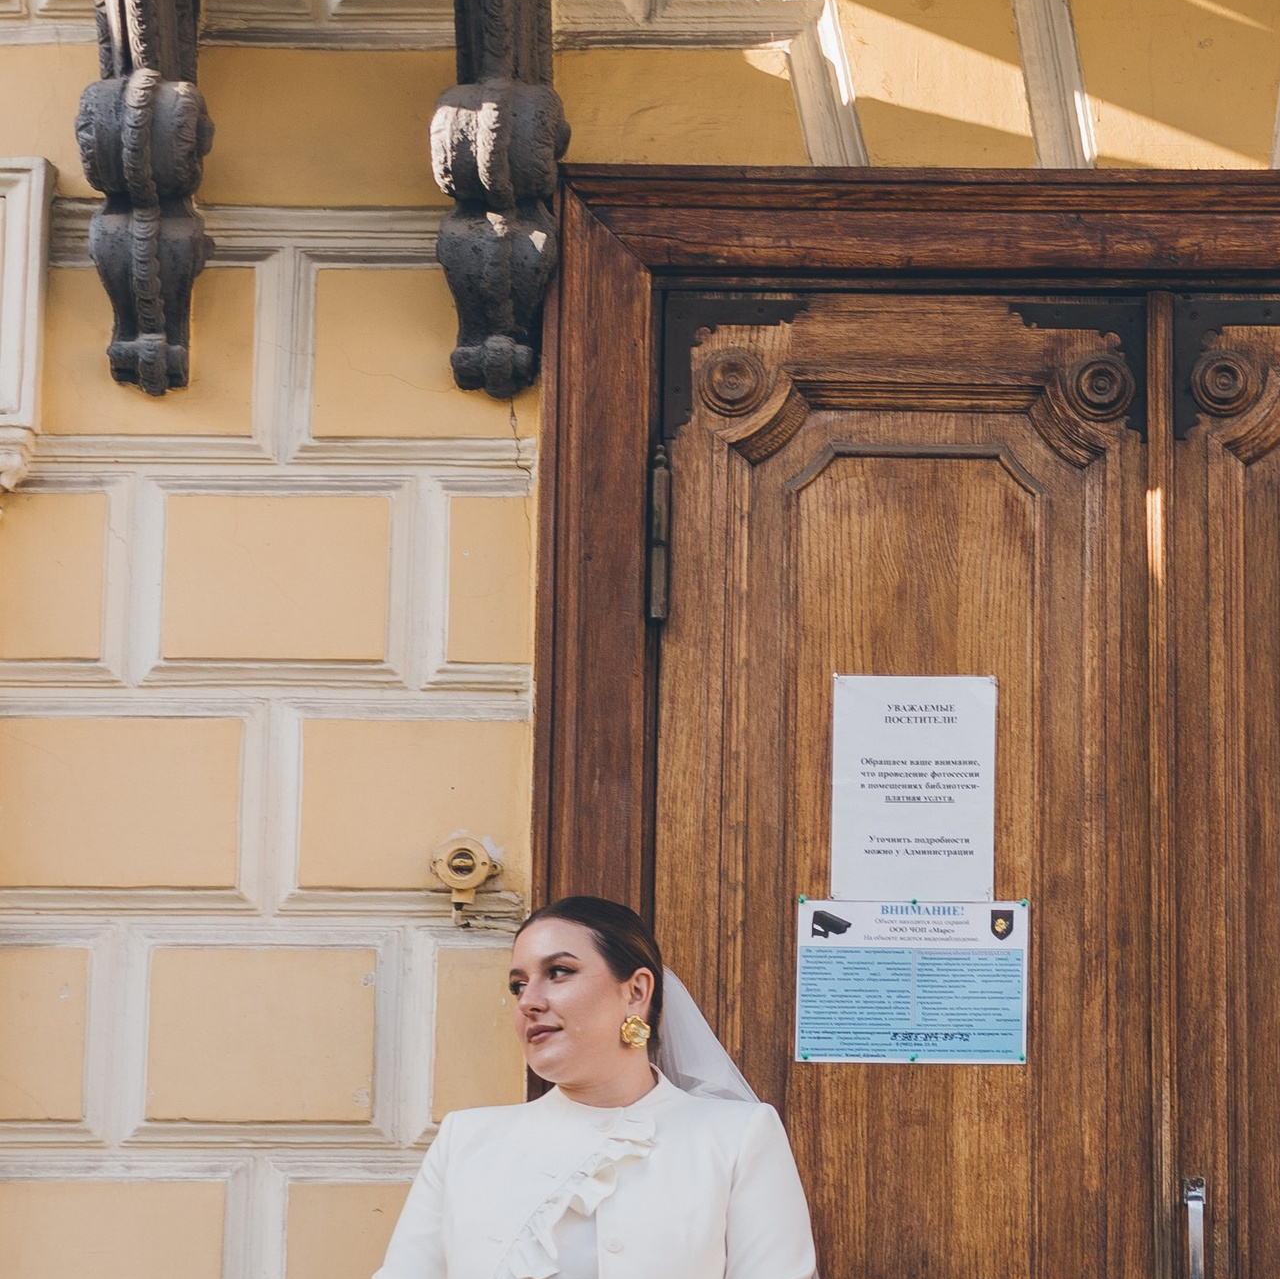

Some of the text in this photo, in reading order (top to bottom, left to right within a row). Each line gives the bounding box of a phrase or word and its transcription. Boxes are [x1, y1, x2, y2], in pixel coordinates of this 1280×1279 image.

[887, 704, 956, 712] УВАЖАЕМЫЕ
[884, 716, 958, 724] ПОСЕТИТЕЛИ!
[861, 758, 907, 767] Обращаем
[878, 771, 928, 780] проведение
[930, 770, 980, 780] фотосессии
[869, 835, 970, 846] Уточнить подробности
[903, 848, 974, 857] Администрации
[881, 905, 964, 916] ВНИМАНИЕ!
